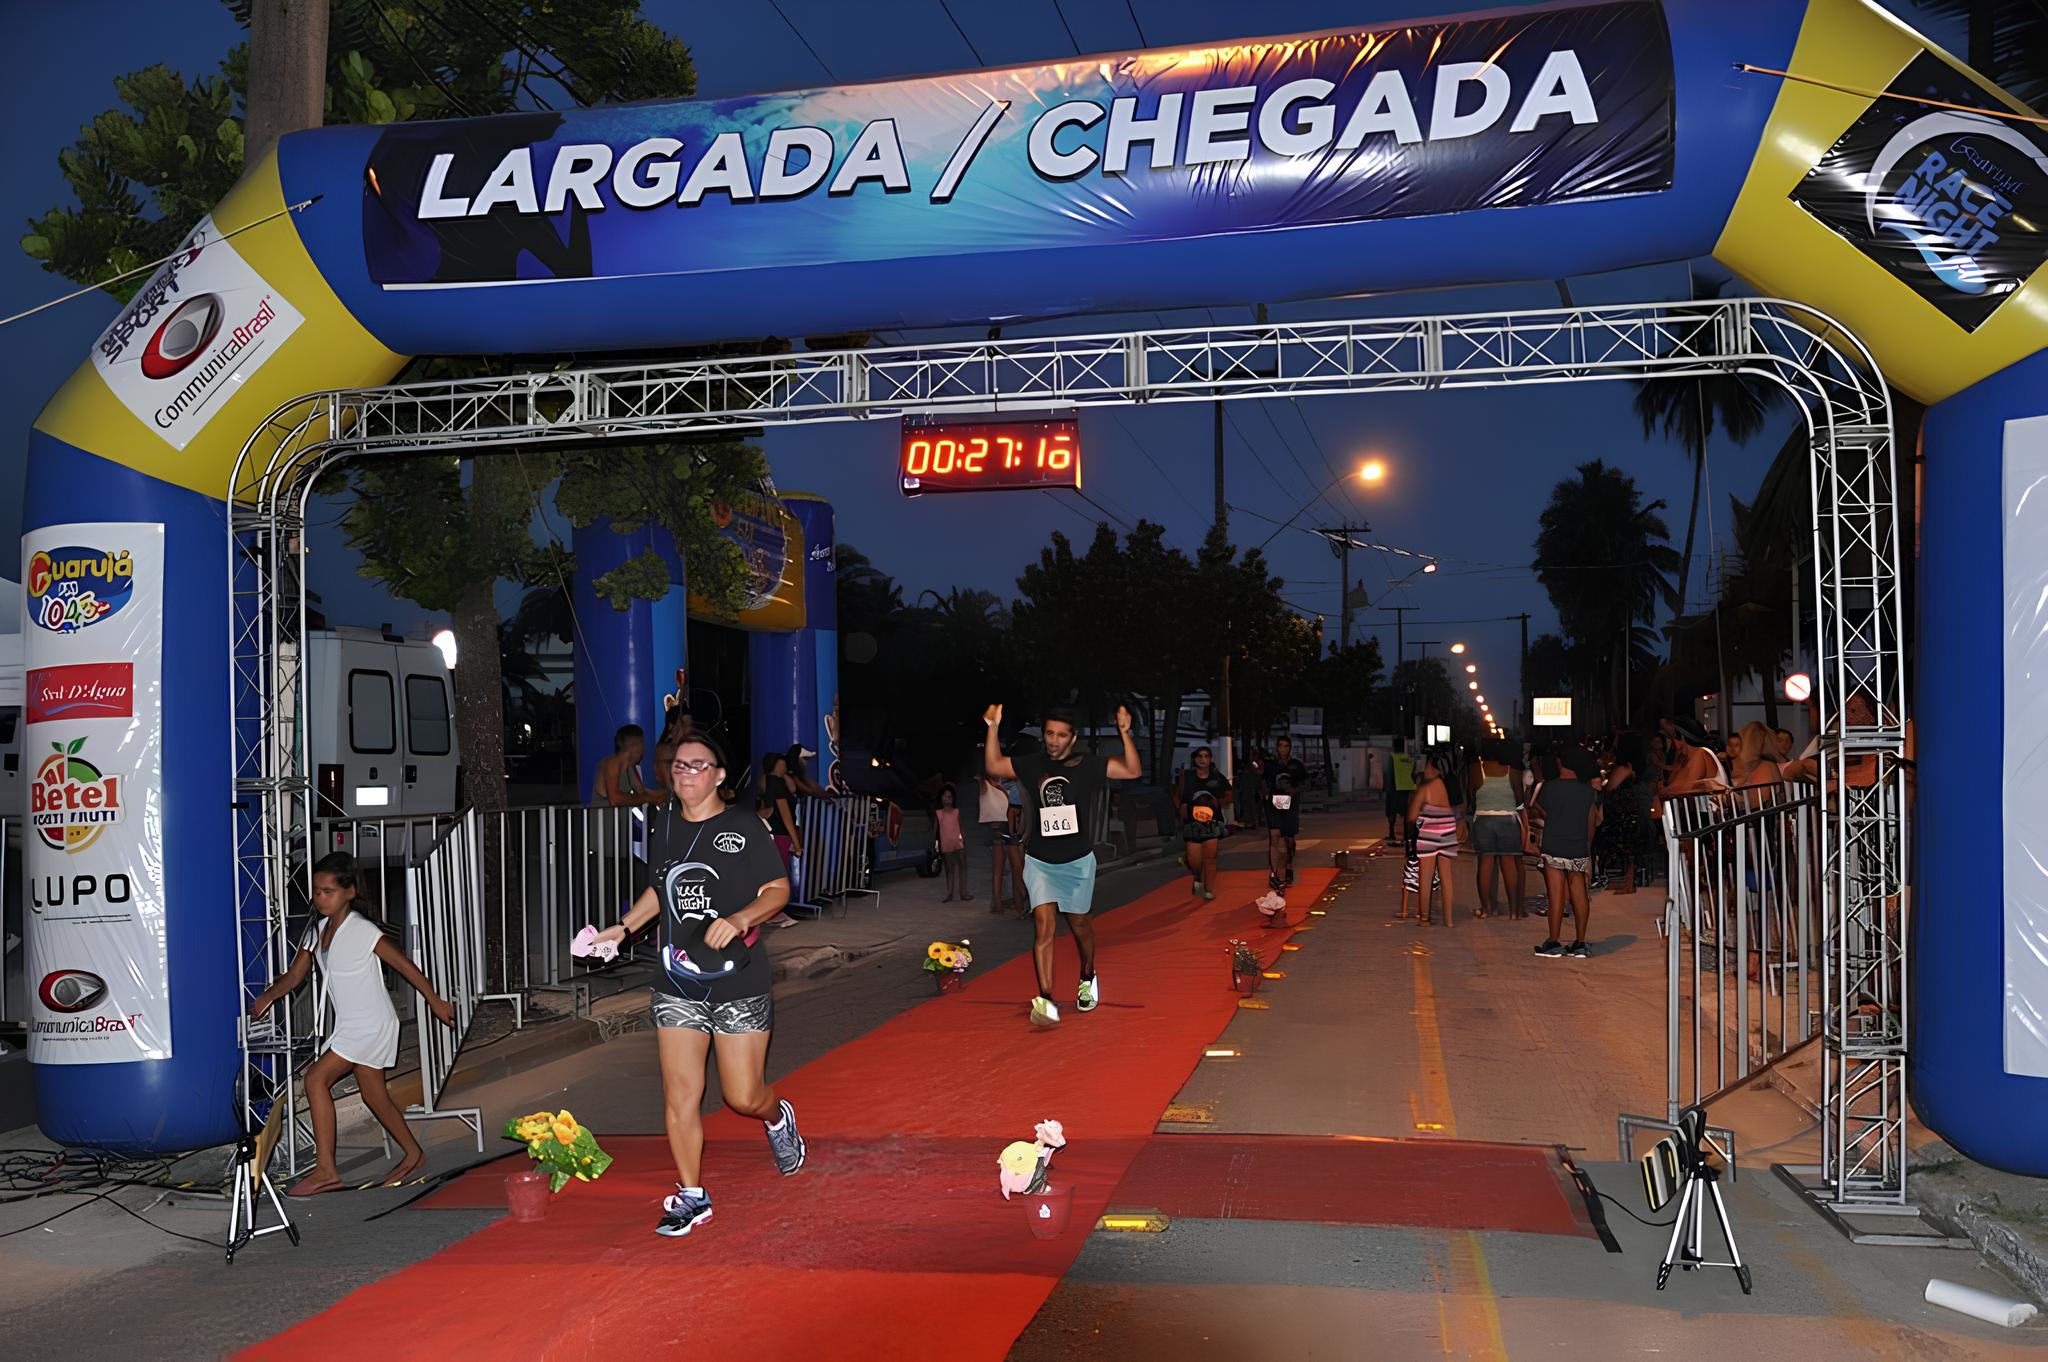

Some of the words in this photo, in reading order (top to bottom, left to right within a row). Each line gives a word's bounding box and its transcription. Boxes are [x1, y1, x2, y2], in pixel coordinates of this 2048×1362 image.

[417, 117, 911, 221] LARGADA
[1027, 49, 1599, 178] CHEGADA
[1892, 174, 2000, 255] NIGHT
[1914, 150, 2015, 230] RACE
[31, 777, 120, 813] Betel
[32, 873, 130, 908] LUPO
